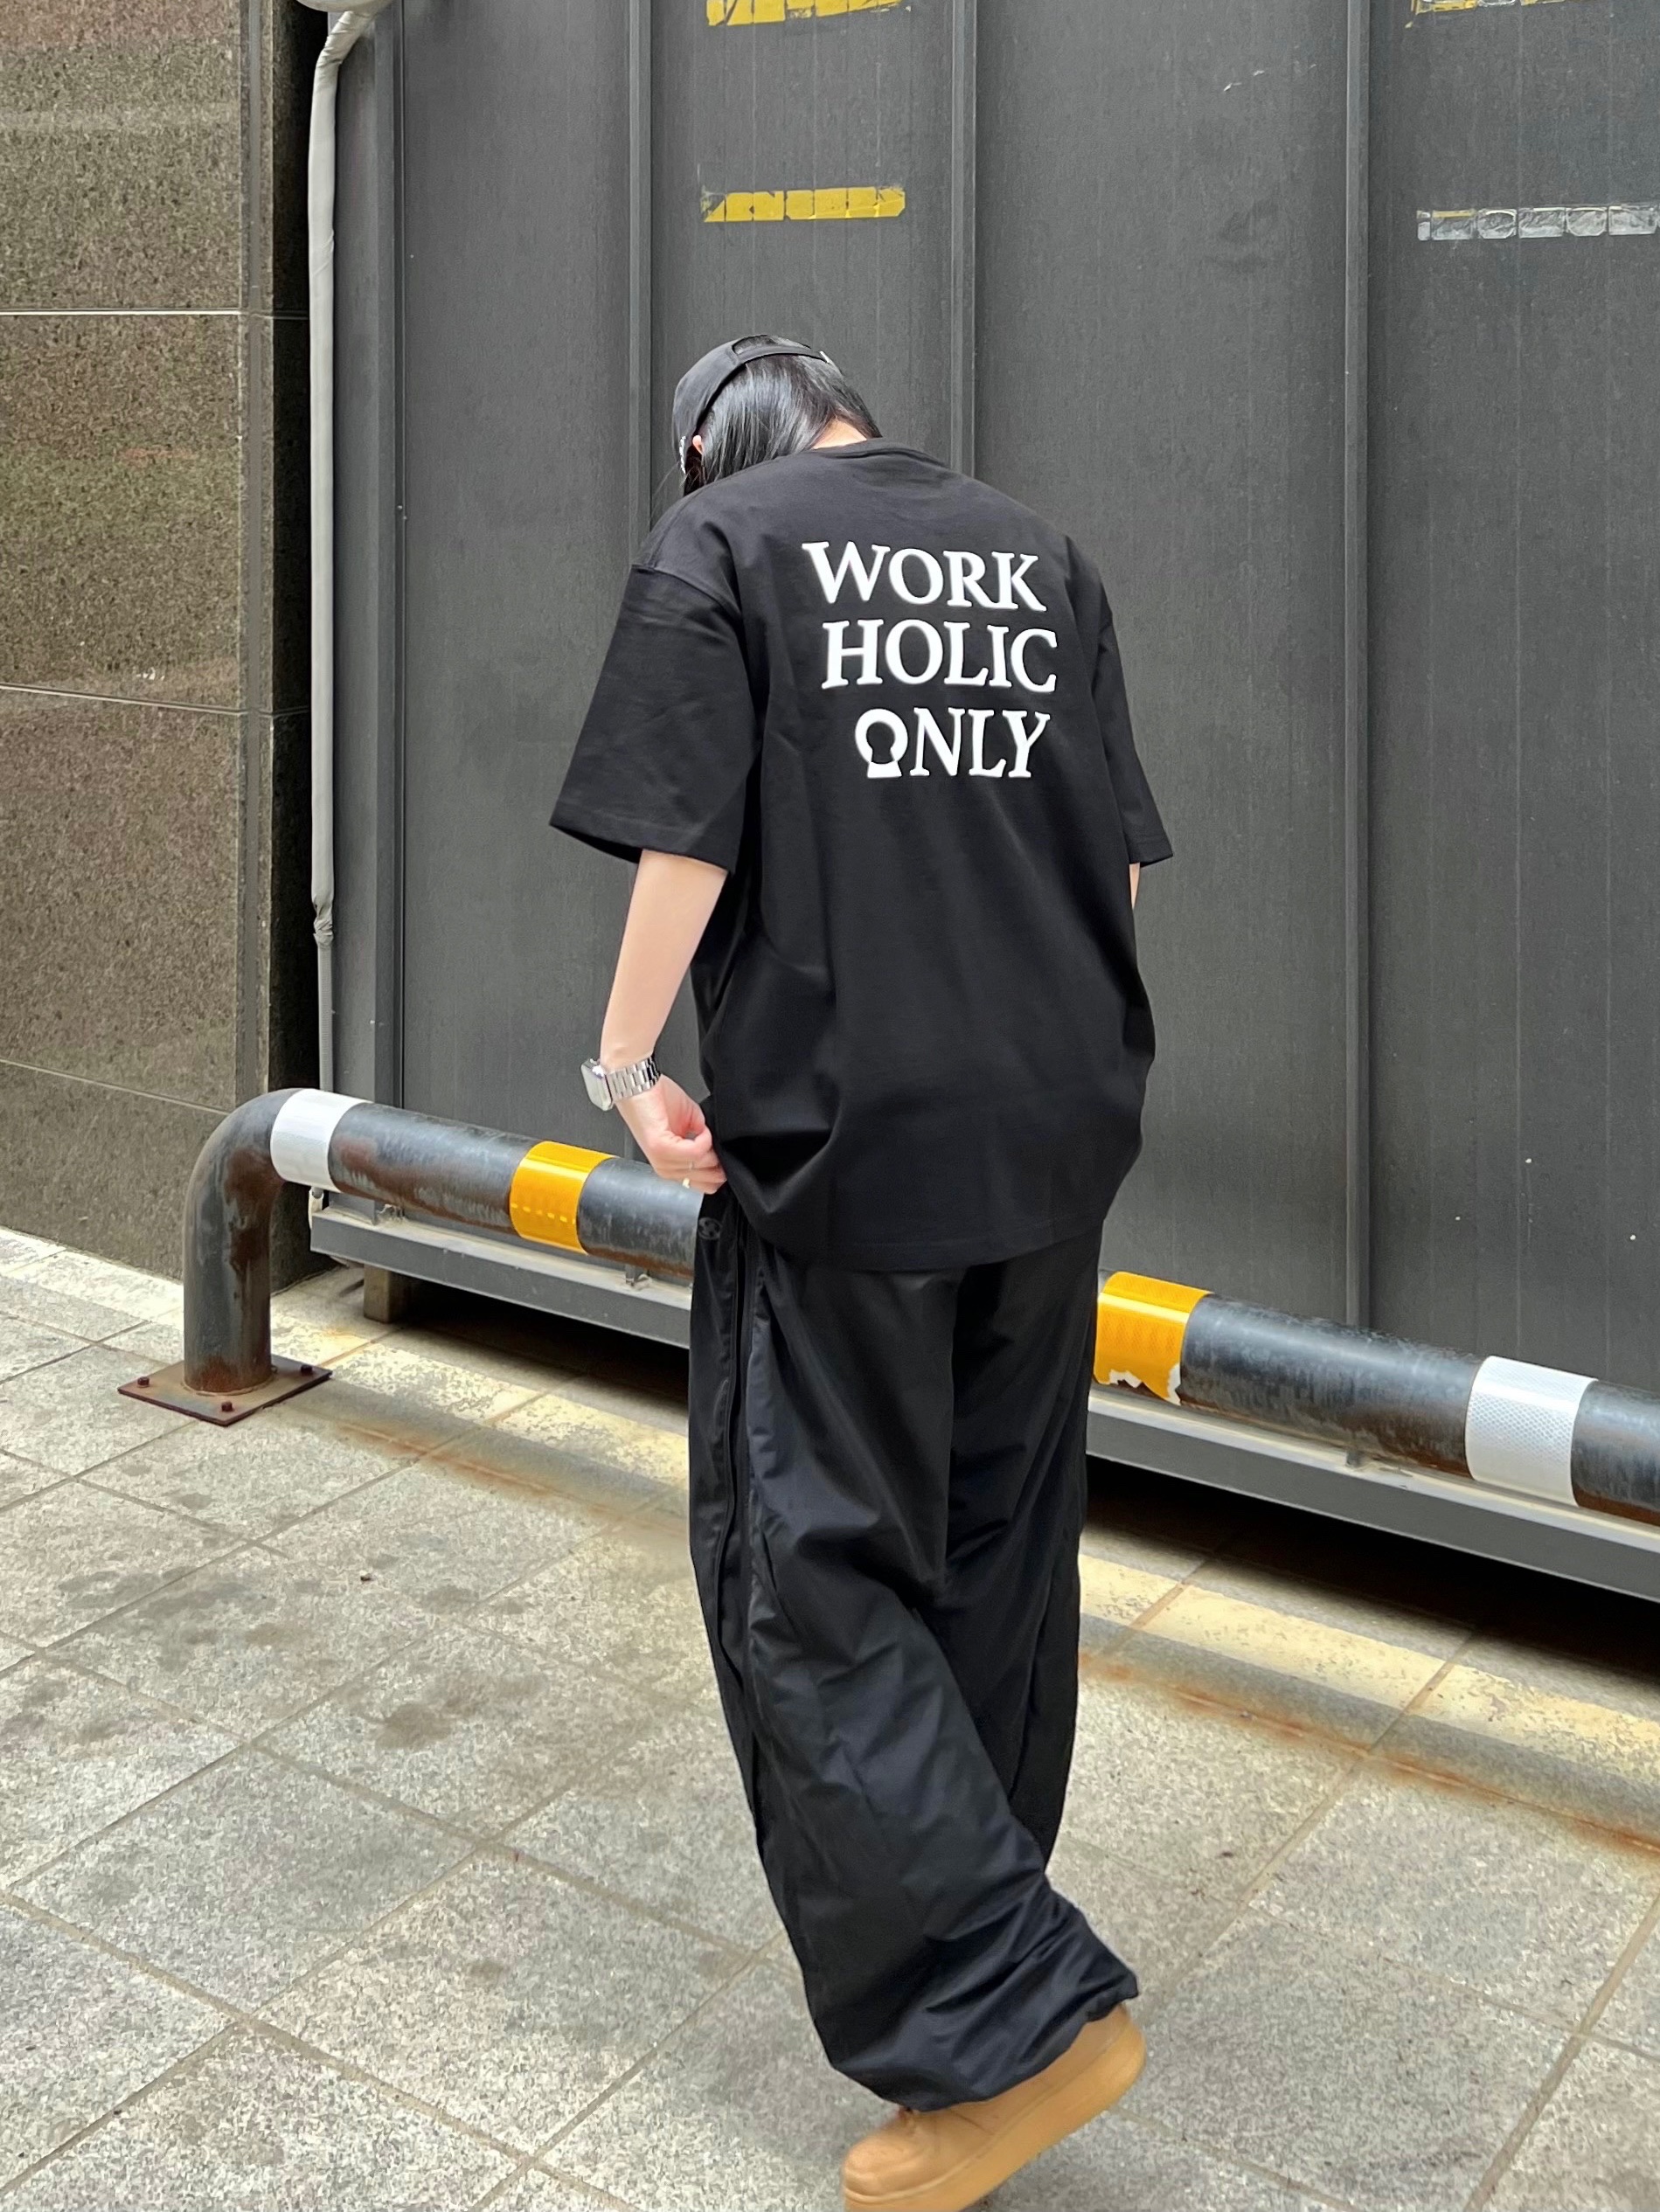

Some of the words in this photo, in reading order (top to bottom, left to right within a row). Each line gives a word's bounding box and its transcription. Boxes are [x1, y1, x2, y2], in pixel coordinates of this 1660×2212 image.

[801, 540, 1047, 612] WORK
[821, 618, 1058, 693] HOLIC
[854, 706, 1051, 780] ONLY
